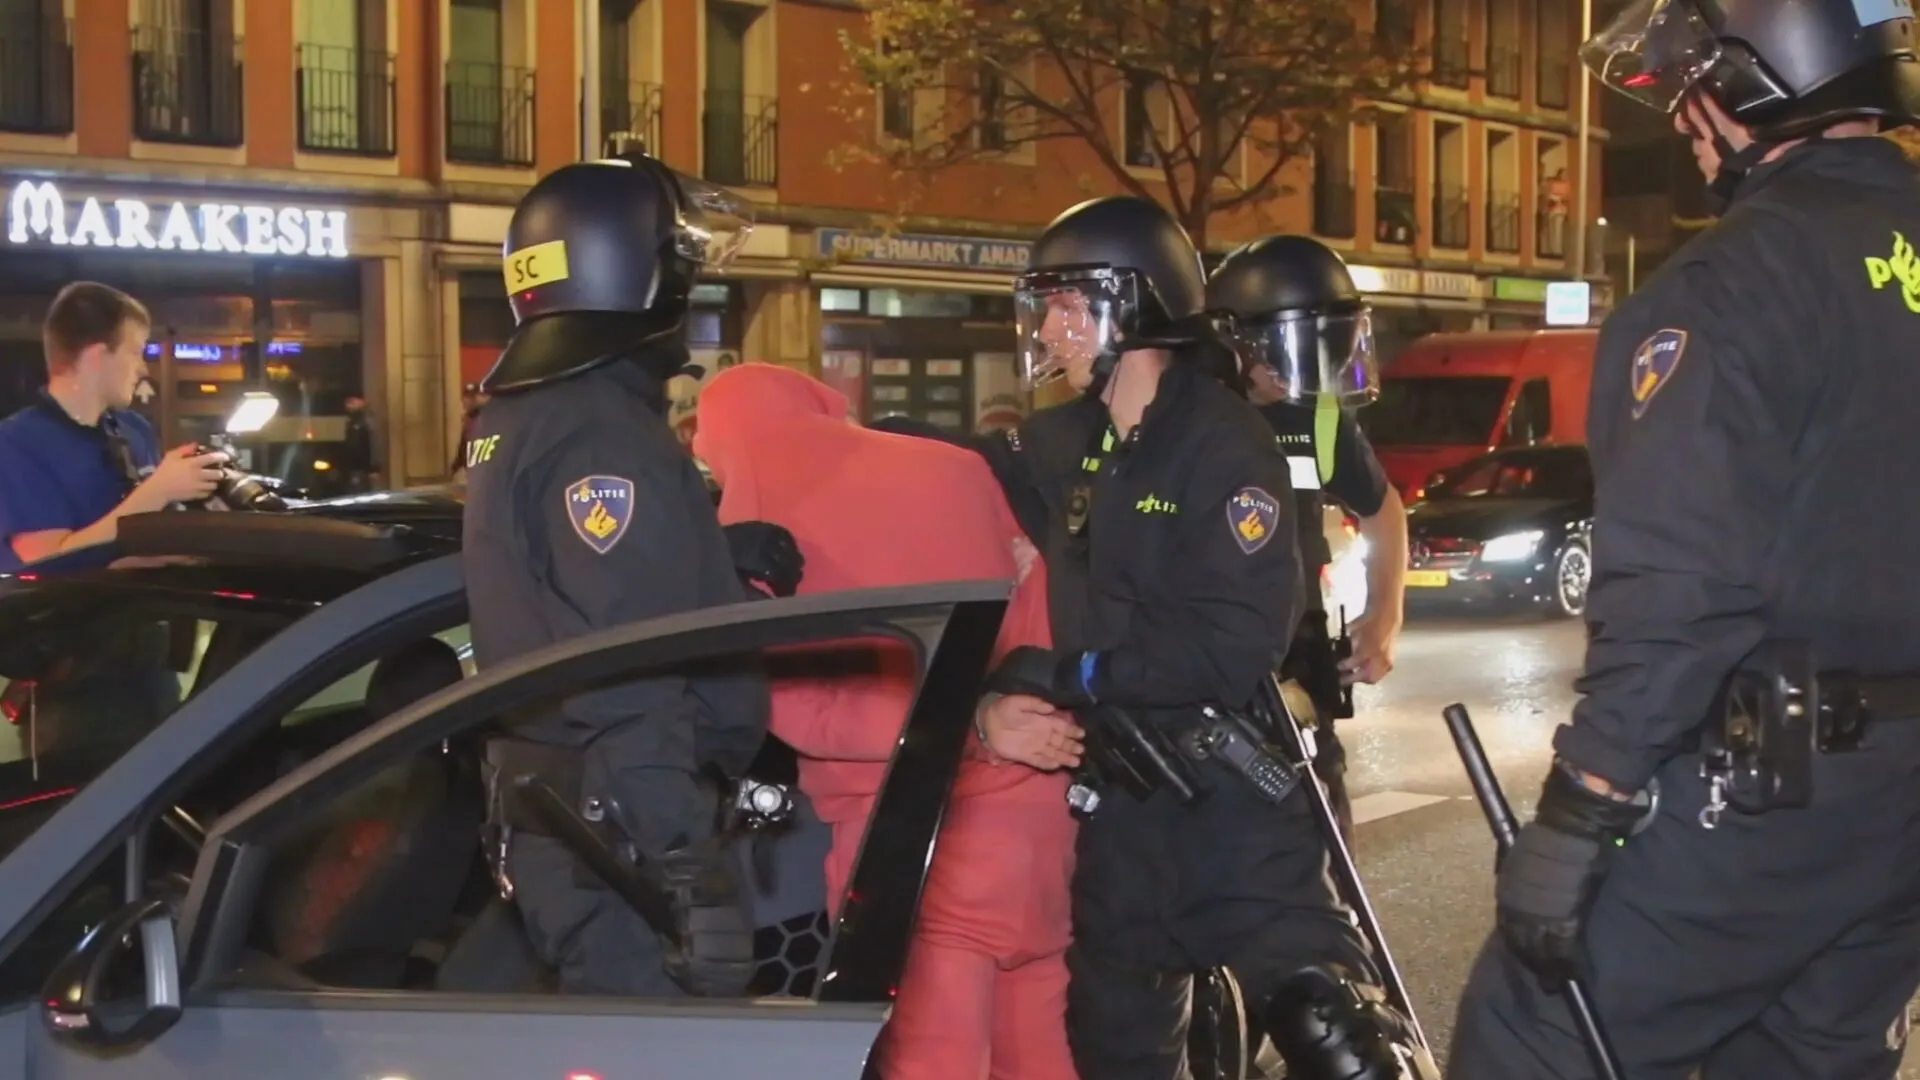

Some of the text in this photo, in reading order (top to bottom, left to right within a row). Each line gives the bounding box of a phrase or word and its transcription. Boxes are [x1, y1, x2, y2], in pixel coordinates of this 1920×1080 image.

[8, 180, 348, 258] MARAKESH
[832, 233, 974, 265] SUPERMARKT
[514, 255, 539, 284] SC
[572, 483, 626, 503] POLITIE
[1232, 493, 1274, 515] POLITIE
